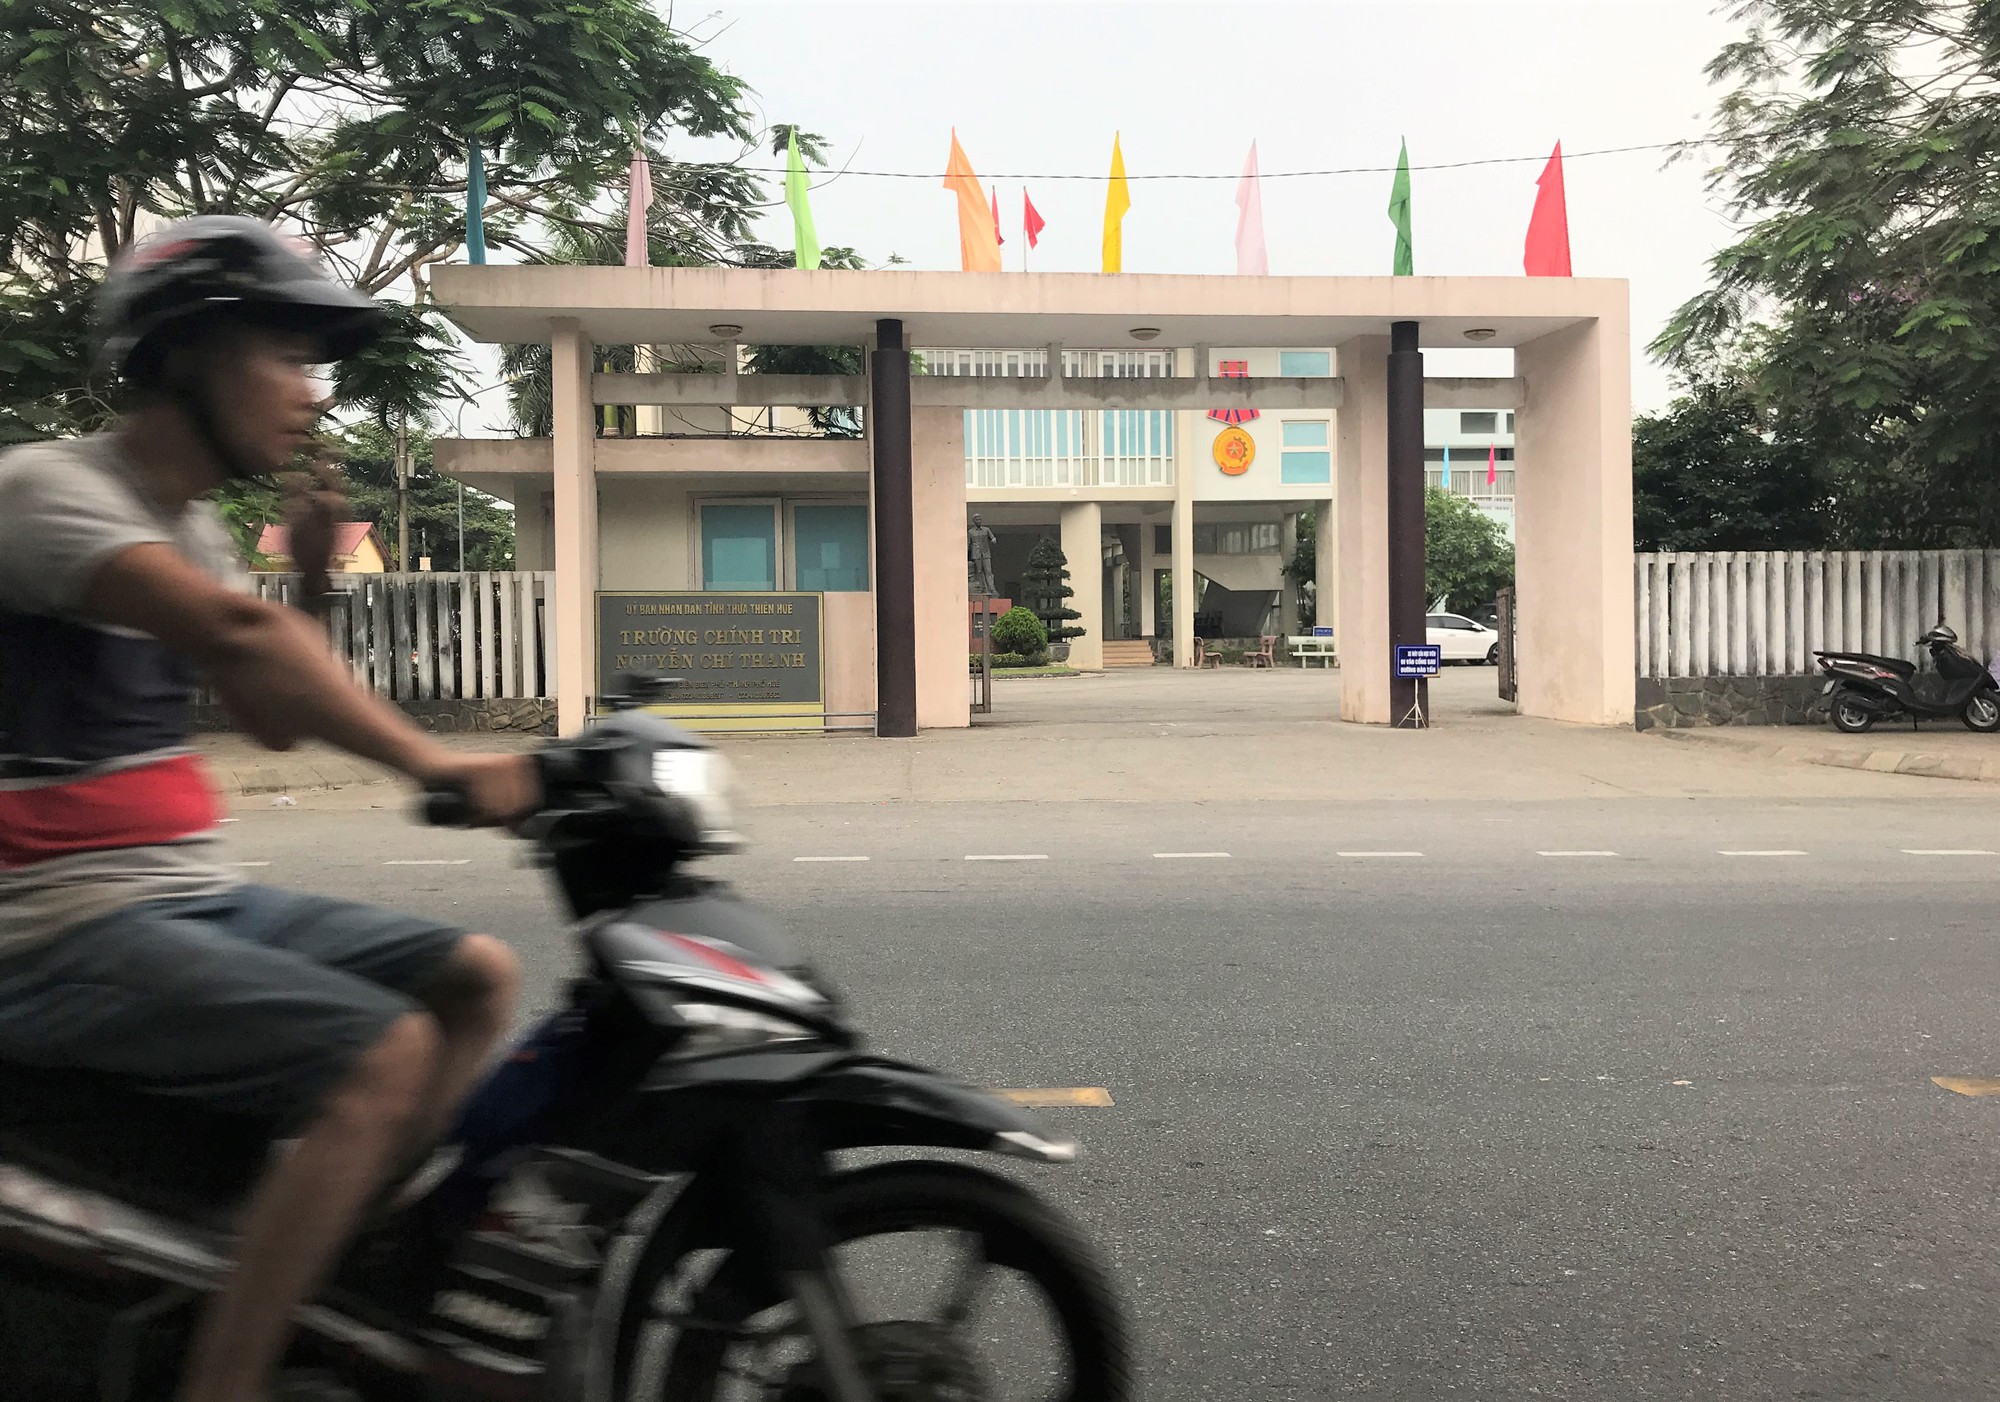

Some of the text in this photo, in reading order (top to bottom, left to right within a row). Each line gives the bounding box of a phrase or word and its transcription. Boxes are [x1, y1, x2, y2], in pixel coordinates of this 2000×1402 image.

[640, 604, 657, 615] BAN
[620, 624, 803, 648] TRƯỜNG CHÍNH TRỊ
[615, 647, 806, 669] NGUYỄN CHÍ THANH
